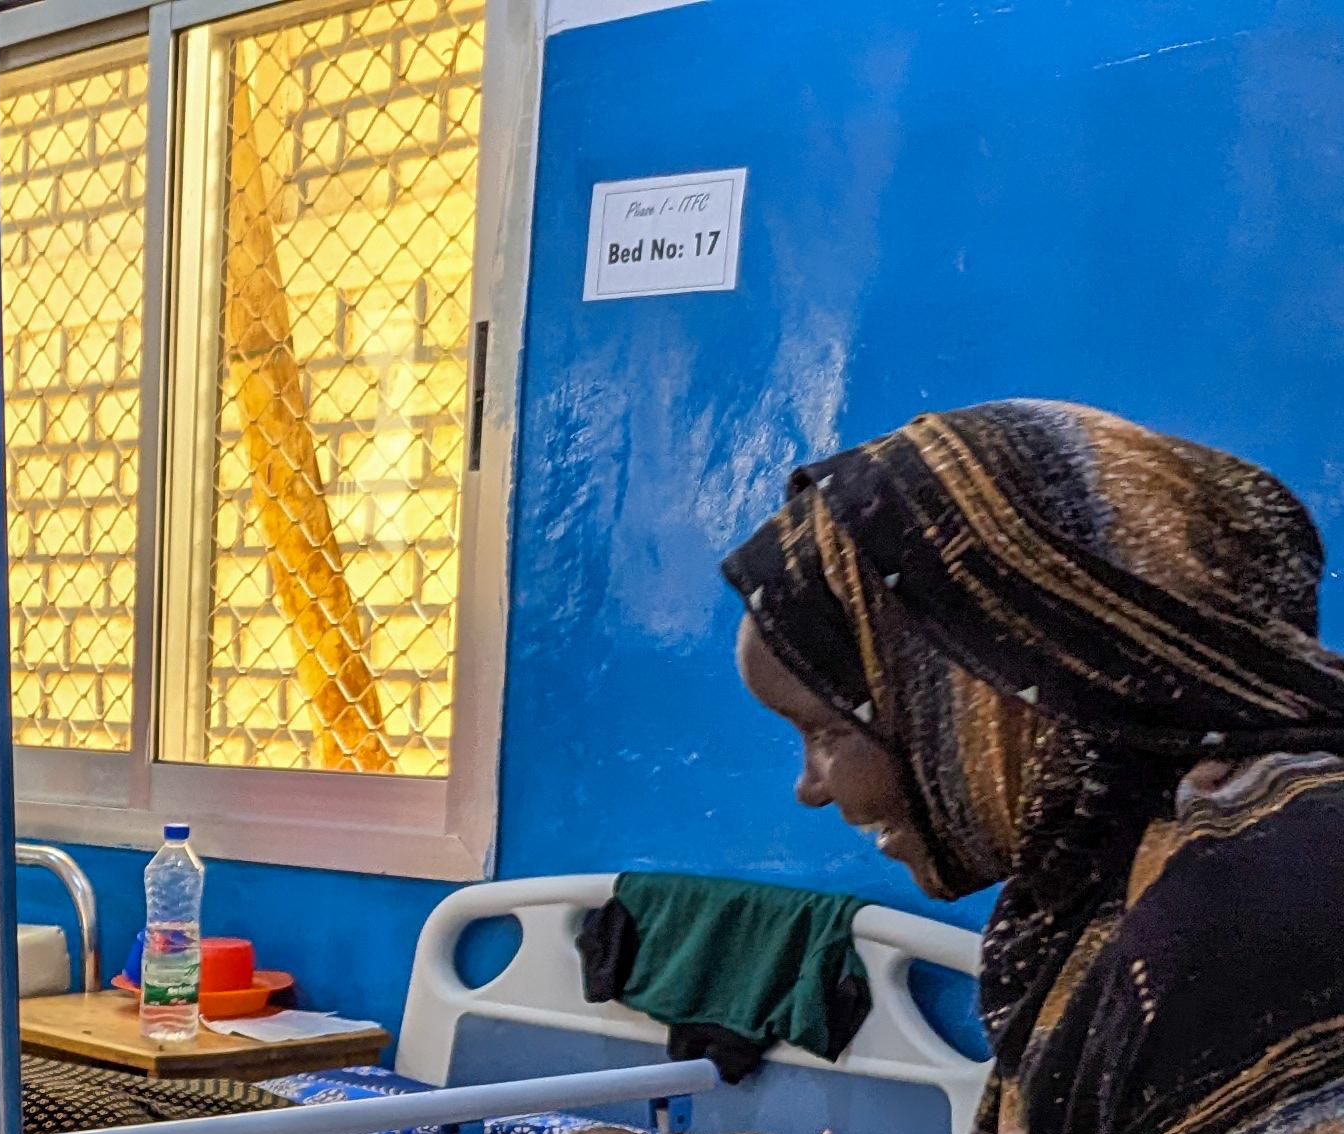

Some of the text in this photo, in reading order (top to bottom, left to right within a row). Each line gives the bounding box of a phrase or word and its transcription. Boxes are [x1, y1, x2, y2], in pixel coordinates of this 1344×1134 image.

[678, 192, 711, 213] ITFC
[608, 230, 721, 266] Bed No: 17
